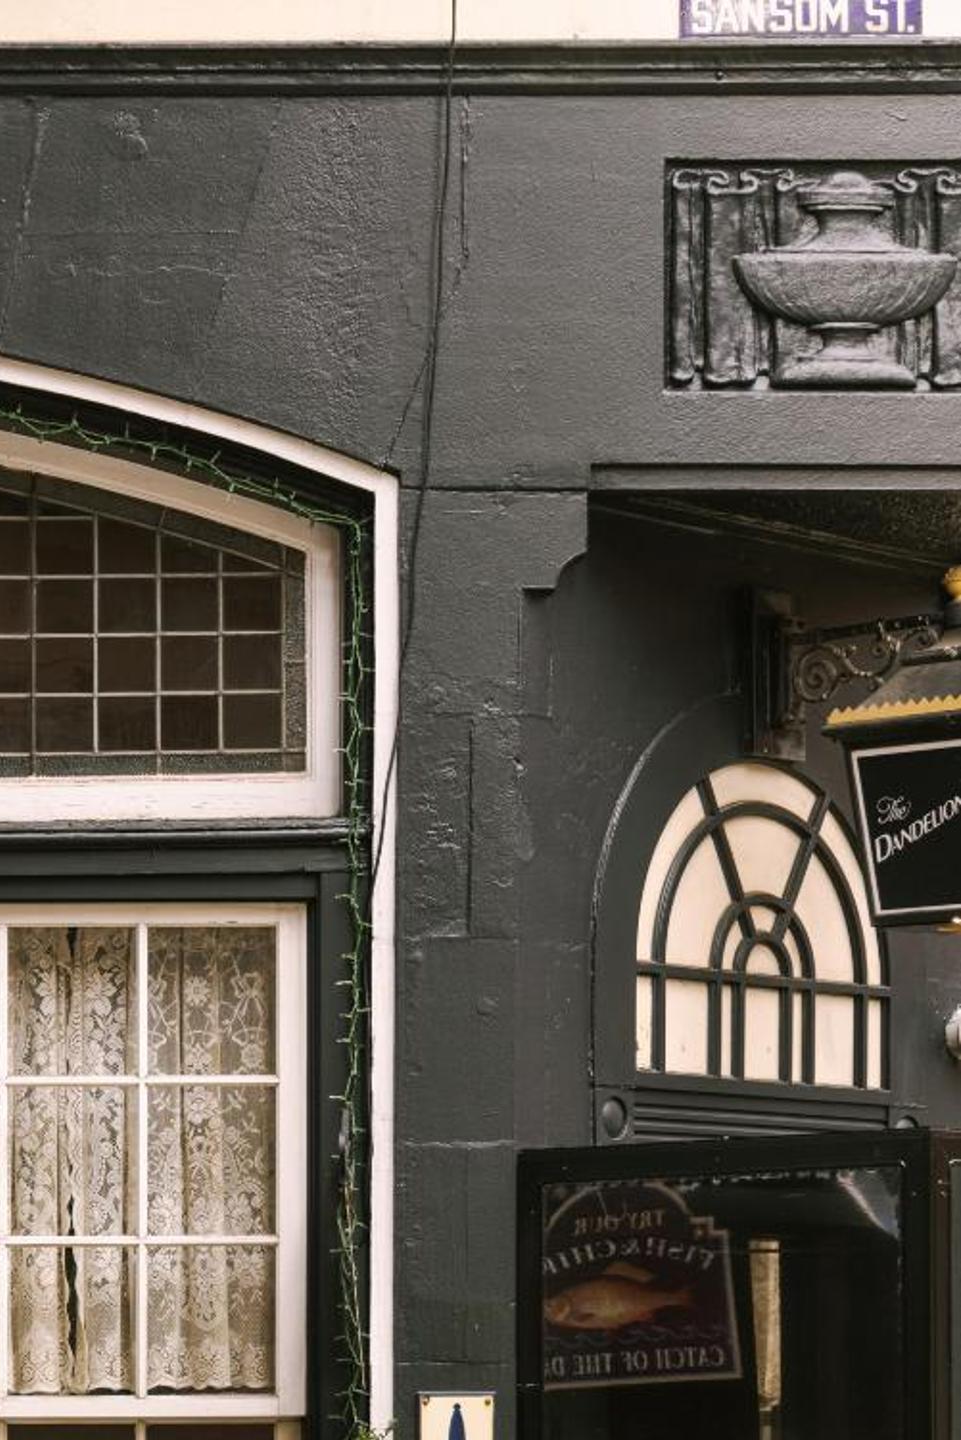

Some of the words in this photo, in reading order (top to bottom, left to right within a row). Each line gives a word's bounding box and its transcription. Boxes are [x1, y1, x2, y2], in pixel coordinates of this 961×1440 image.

[691, 0, 849, 33] SANSOM
[864, 0, 916, 33] ST.
[876, 795, 912, 825] The
